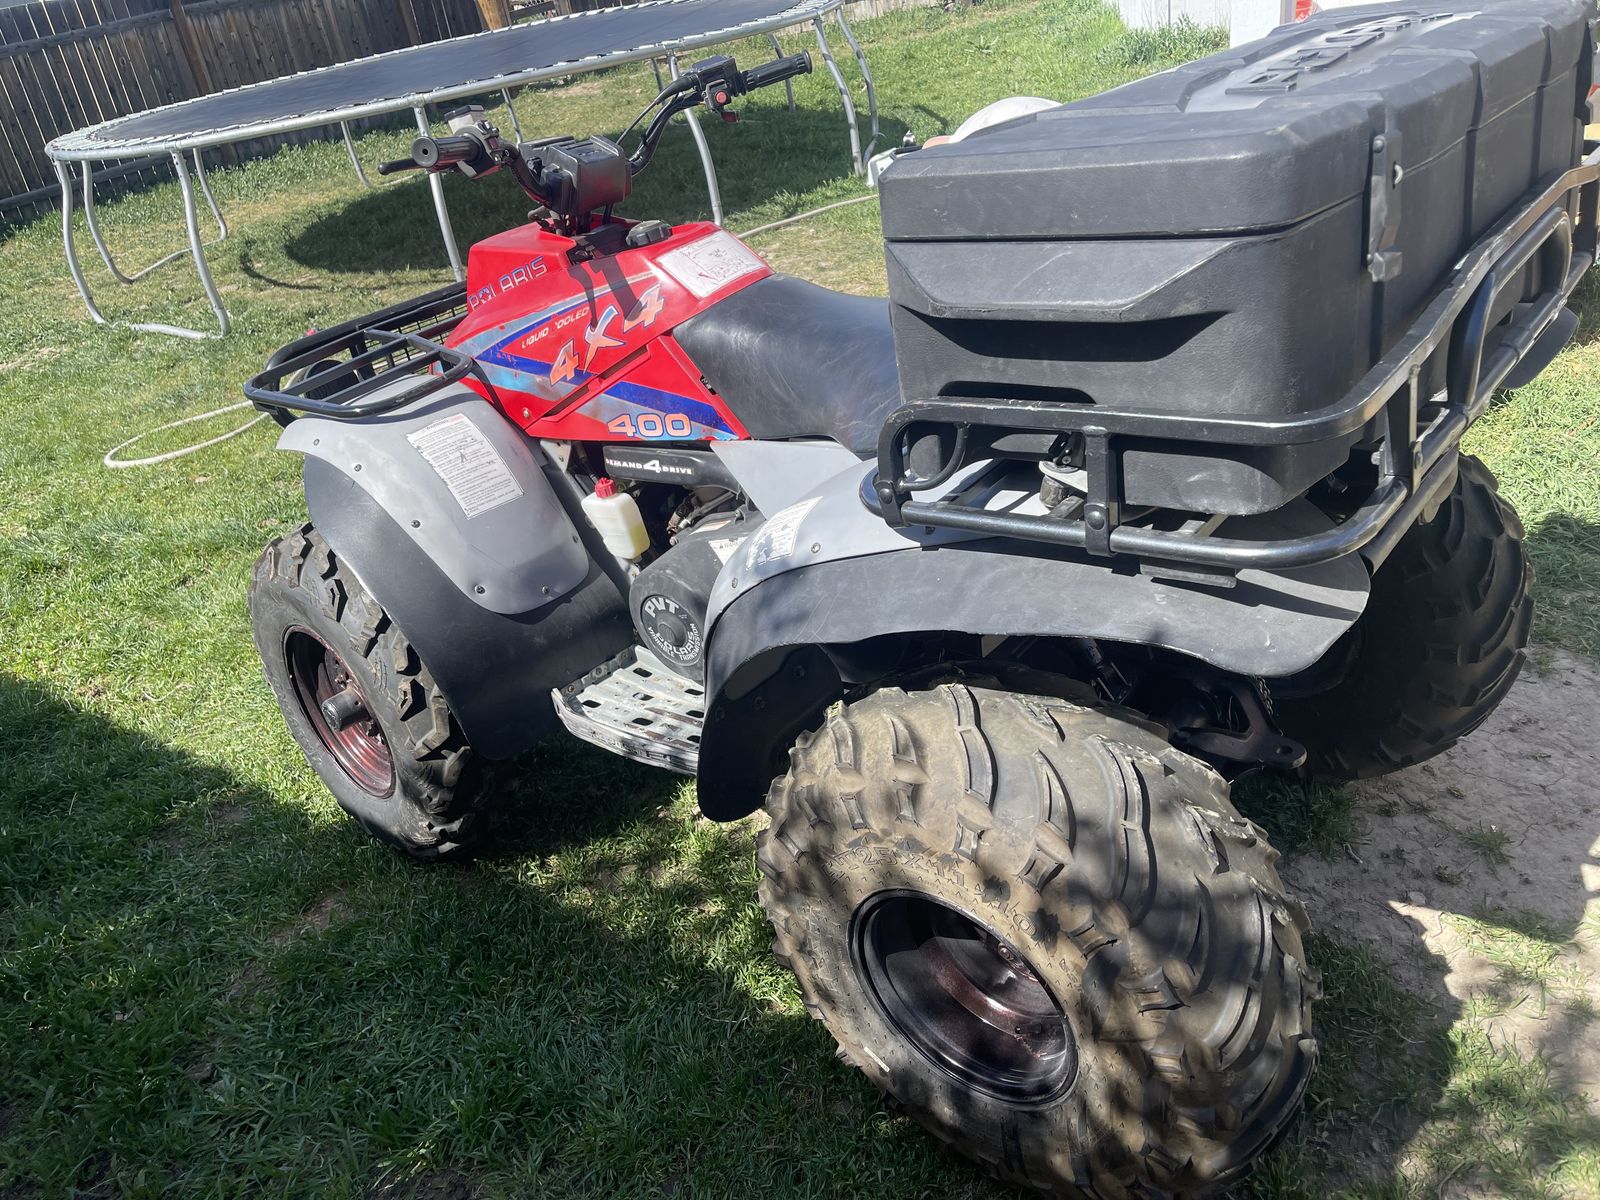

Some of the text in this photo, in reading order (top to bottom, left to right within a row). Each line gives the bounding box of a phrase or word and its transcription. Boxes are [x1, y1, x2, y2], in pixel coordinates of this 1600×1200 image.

[521, 307, 589, 349] LIQUID OOLED
[607, 412, 692, 437] 400
[662, 465, 693, 475] DRIVE
[644, 597, 680, 618] PVT
[655, 631, 695, 655] POLARIS
